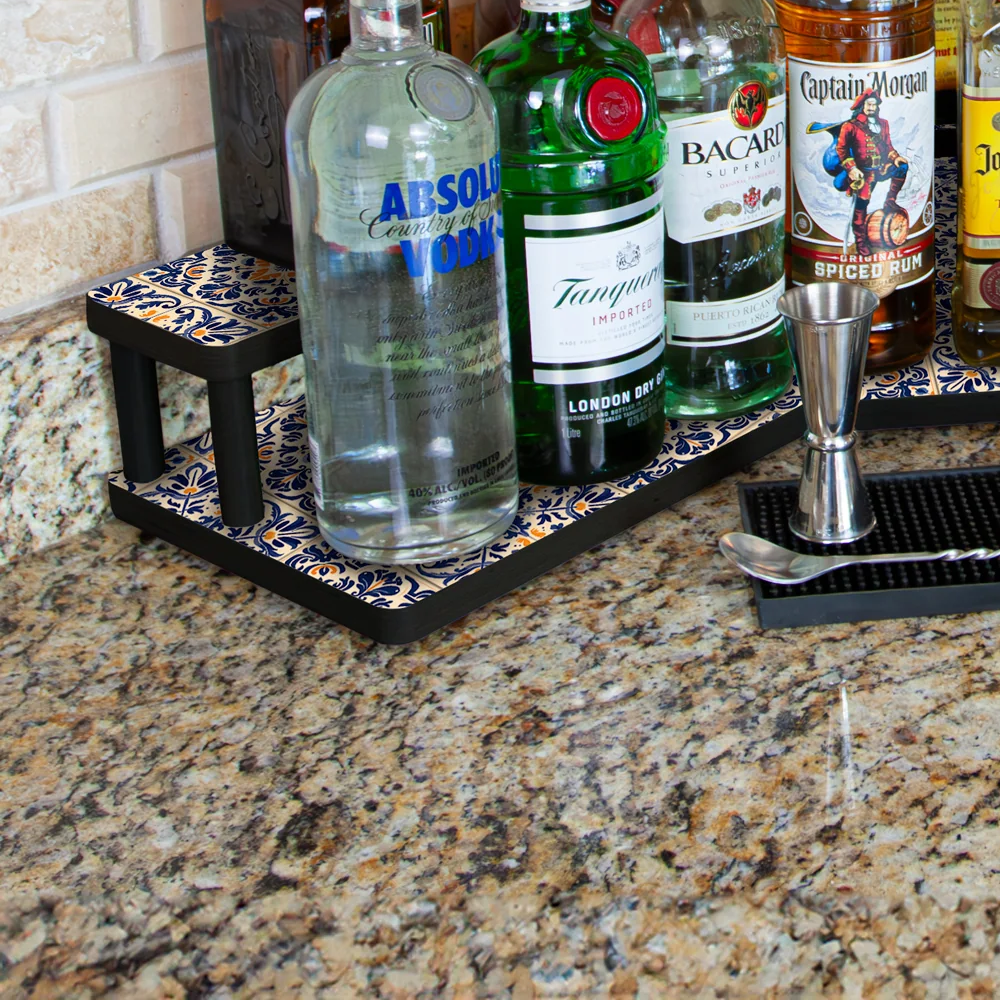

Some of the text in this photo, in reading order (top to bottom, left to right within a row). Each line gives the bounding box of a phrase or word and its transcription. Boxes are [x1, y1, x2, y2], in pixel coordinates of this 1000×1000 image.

[800, 69, 929, 105] Captain Morgan
[706, 151, 781, 179] SUPERIOR
[359, 208, 458, 242] Country
[814, 261, 883, 280] SPICED
[889, 251, 923, 277] RUM
[840, 250, 904, 263] ORIGINAL
[592, 298, 652, 327] IMPORTED
[693, 299, 771, 322] PUERTO RICAN
[568, 390, 631, 414] LONDON
[634, 378, 654, 400] DRY
[561, 413, 594, 422] PRODUCED
[567, 428, 581, 439] Litre
[457, 450, 500, 477] IMPORTED
[408, 486, 433, 498] 40%
